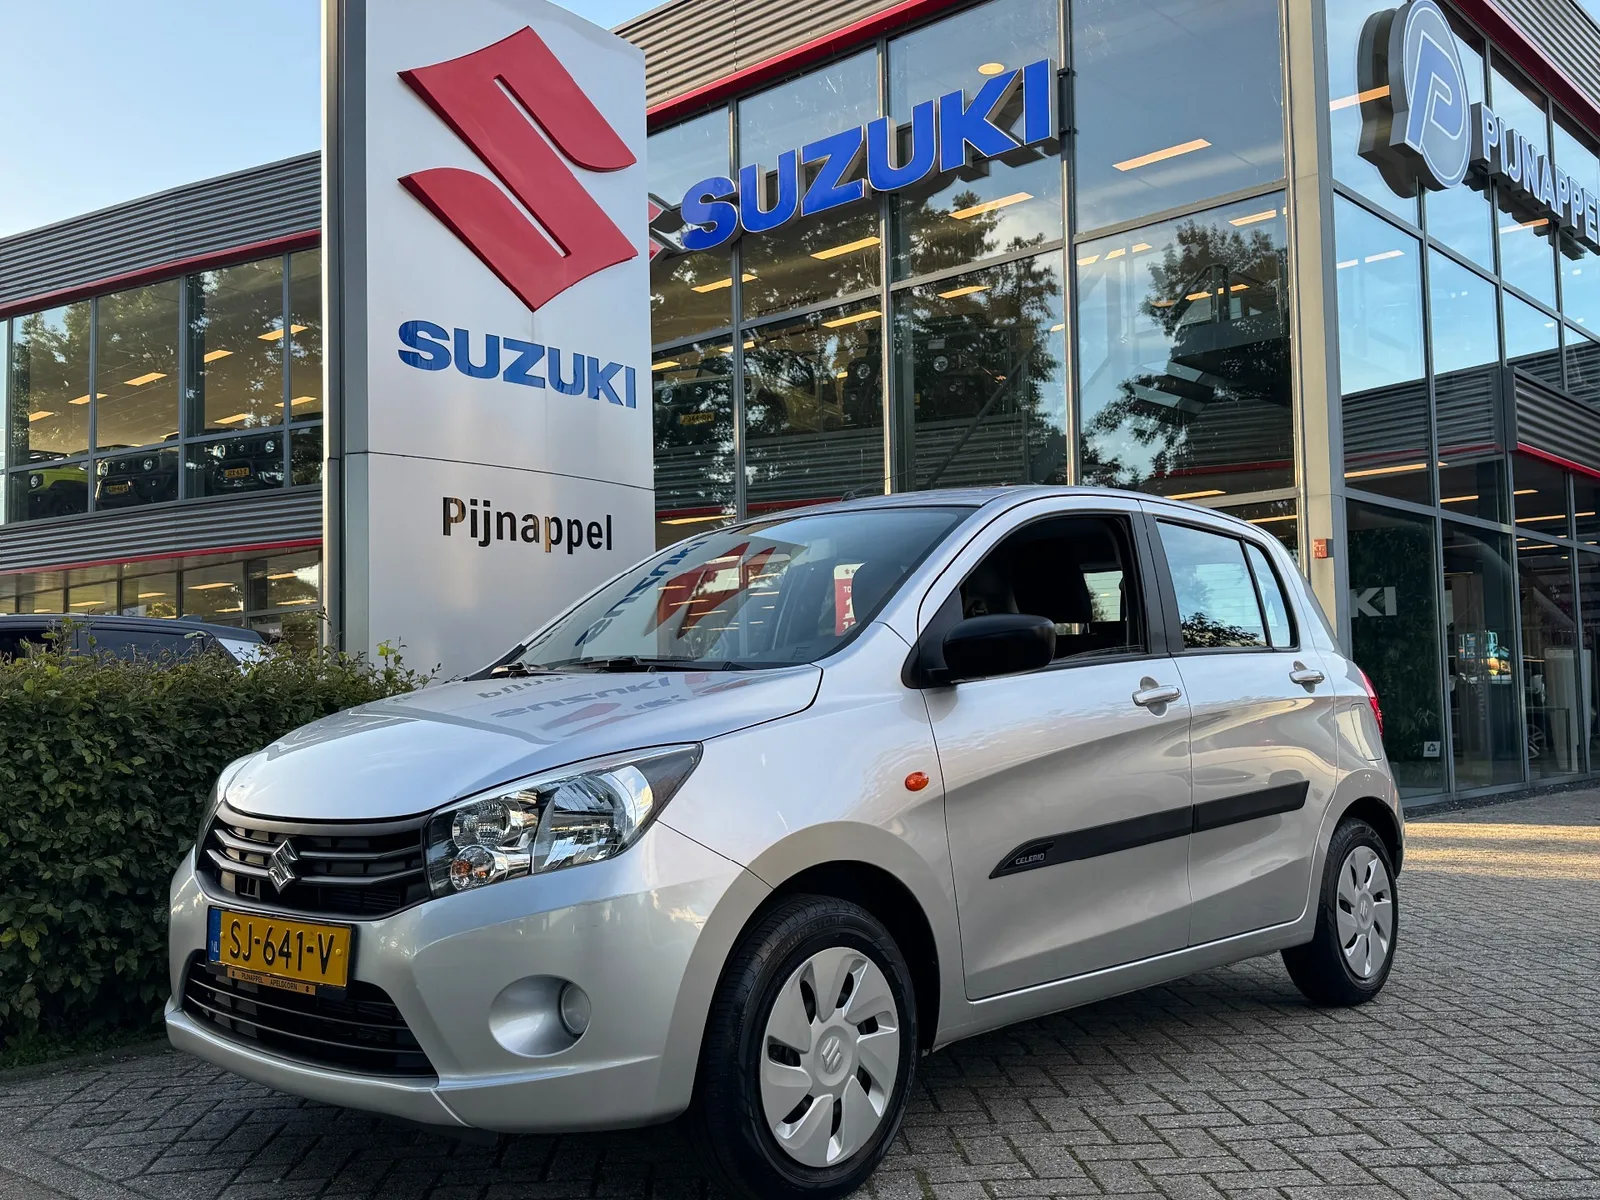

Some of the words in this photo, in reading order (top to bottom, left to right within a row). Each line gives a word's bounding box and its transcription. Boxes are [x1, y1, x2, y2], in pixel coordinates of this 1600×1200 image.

[680, 58, 1056, 252] SUZUKI
[1481, 101, 1600, 247] PIJNAPPE
[398, 320, 637, 409] SUZUKI
[443, 497, 613, 555] Pijnappel
[1015, 853, 1045, 865] CELERIO
[210, 940, 219, 953] NL
[229, 919, 336, 975] SJ-641-V
